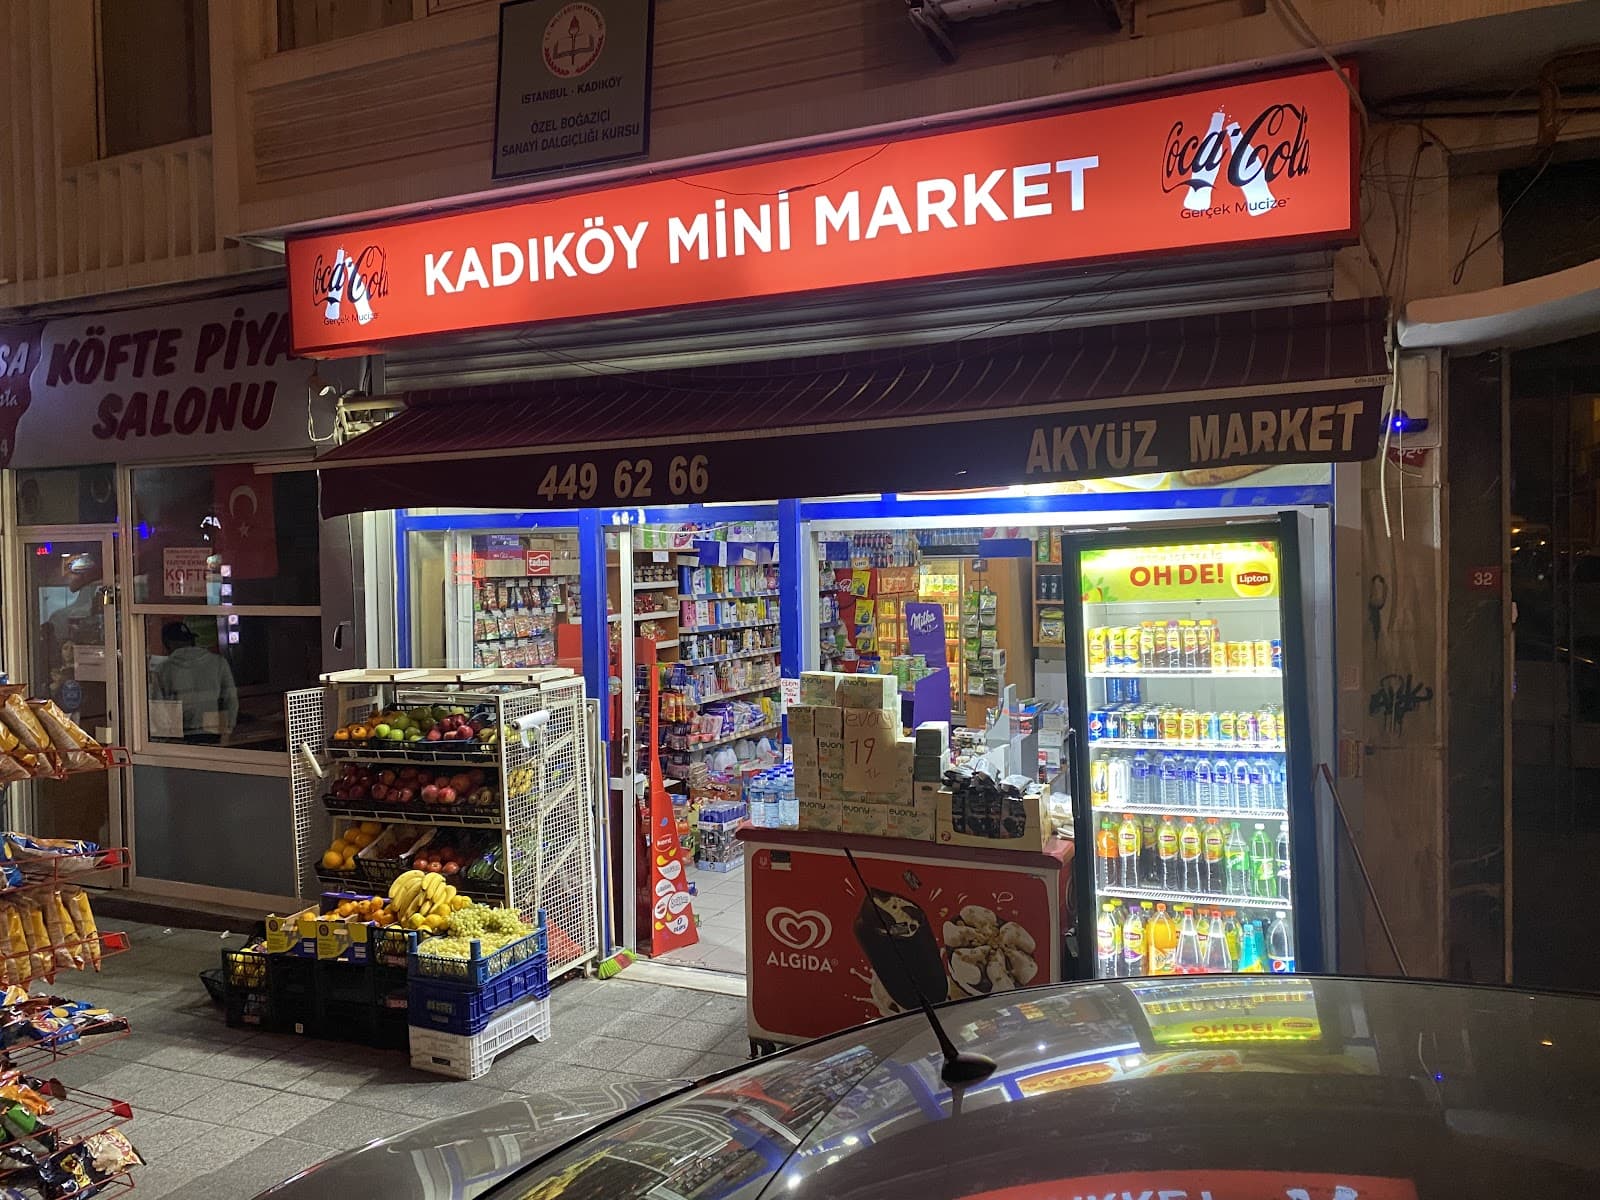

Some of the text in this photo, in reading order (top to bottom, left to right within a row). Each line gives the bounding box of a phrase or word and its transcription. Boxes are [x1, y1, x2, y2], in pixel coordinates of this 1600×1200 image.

[602, 123, 639, 140] KURSU
[1161, 103, 1311, 193] Coca-Cola
[1180, 202, 1231, 220] Gerçek
[424, 155, 1099, 296] KADIKÖY MİNİ MARKET
[313, 245, 389, 306] Coca-Cola
[46, 308, 299, 387] KÖFTE PİYA
[92, 380, 278, 440] SALONU
[1025, 400, 1364, 474] AKYÜZ MARKET
[537, 454, 709, 501] 449 62 66
[1130, 563, 1224, 587] OH DE!
[1239, 575, 1269, 584] Lipton
[1474, 572, 1493, 586] 32
[820, 741, 845, 749] evon
[850, 737, 876, 764] 19
[822, 772, 844, 780] evon
[888, 807, 918, 818] evony
